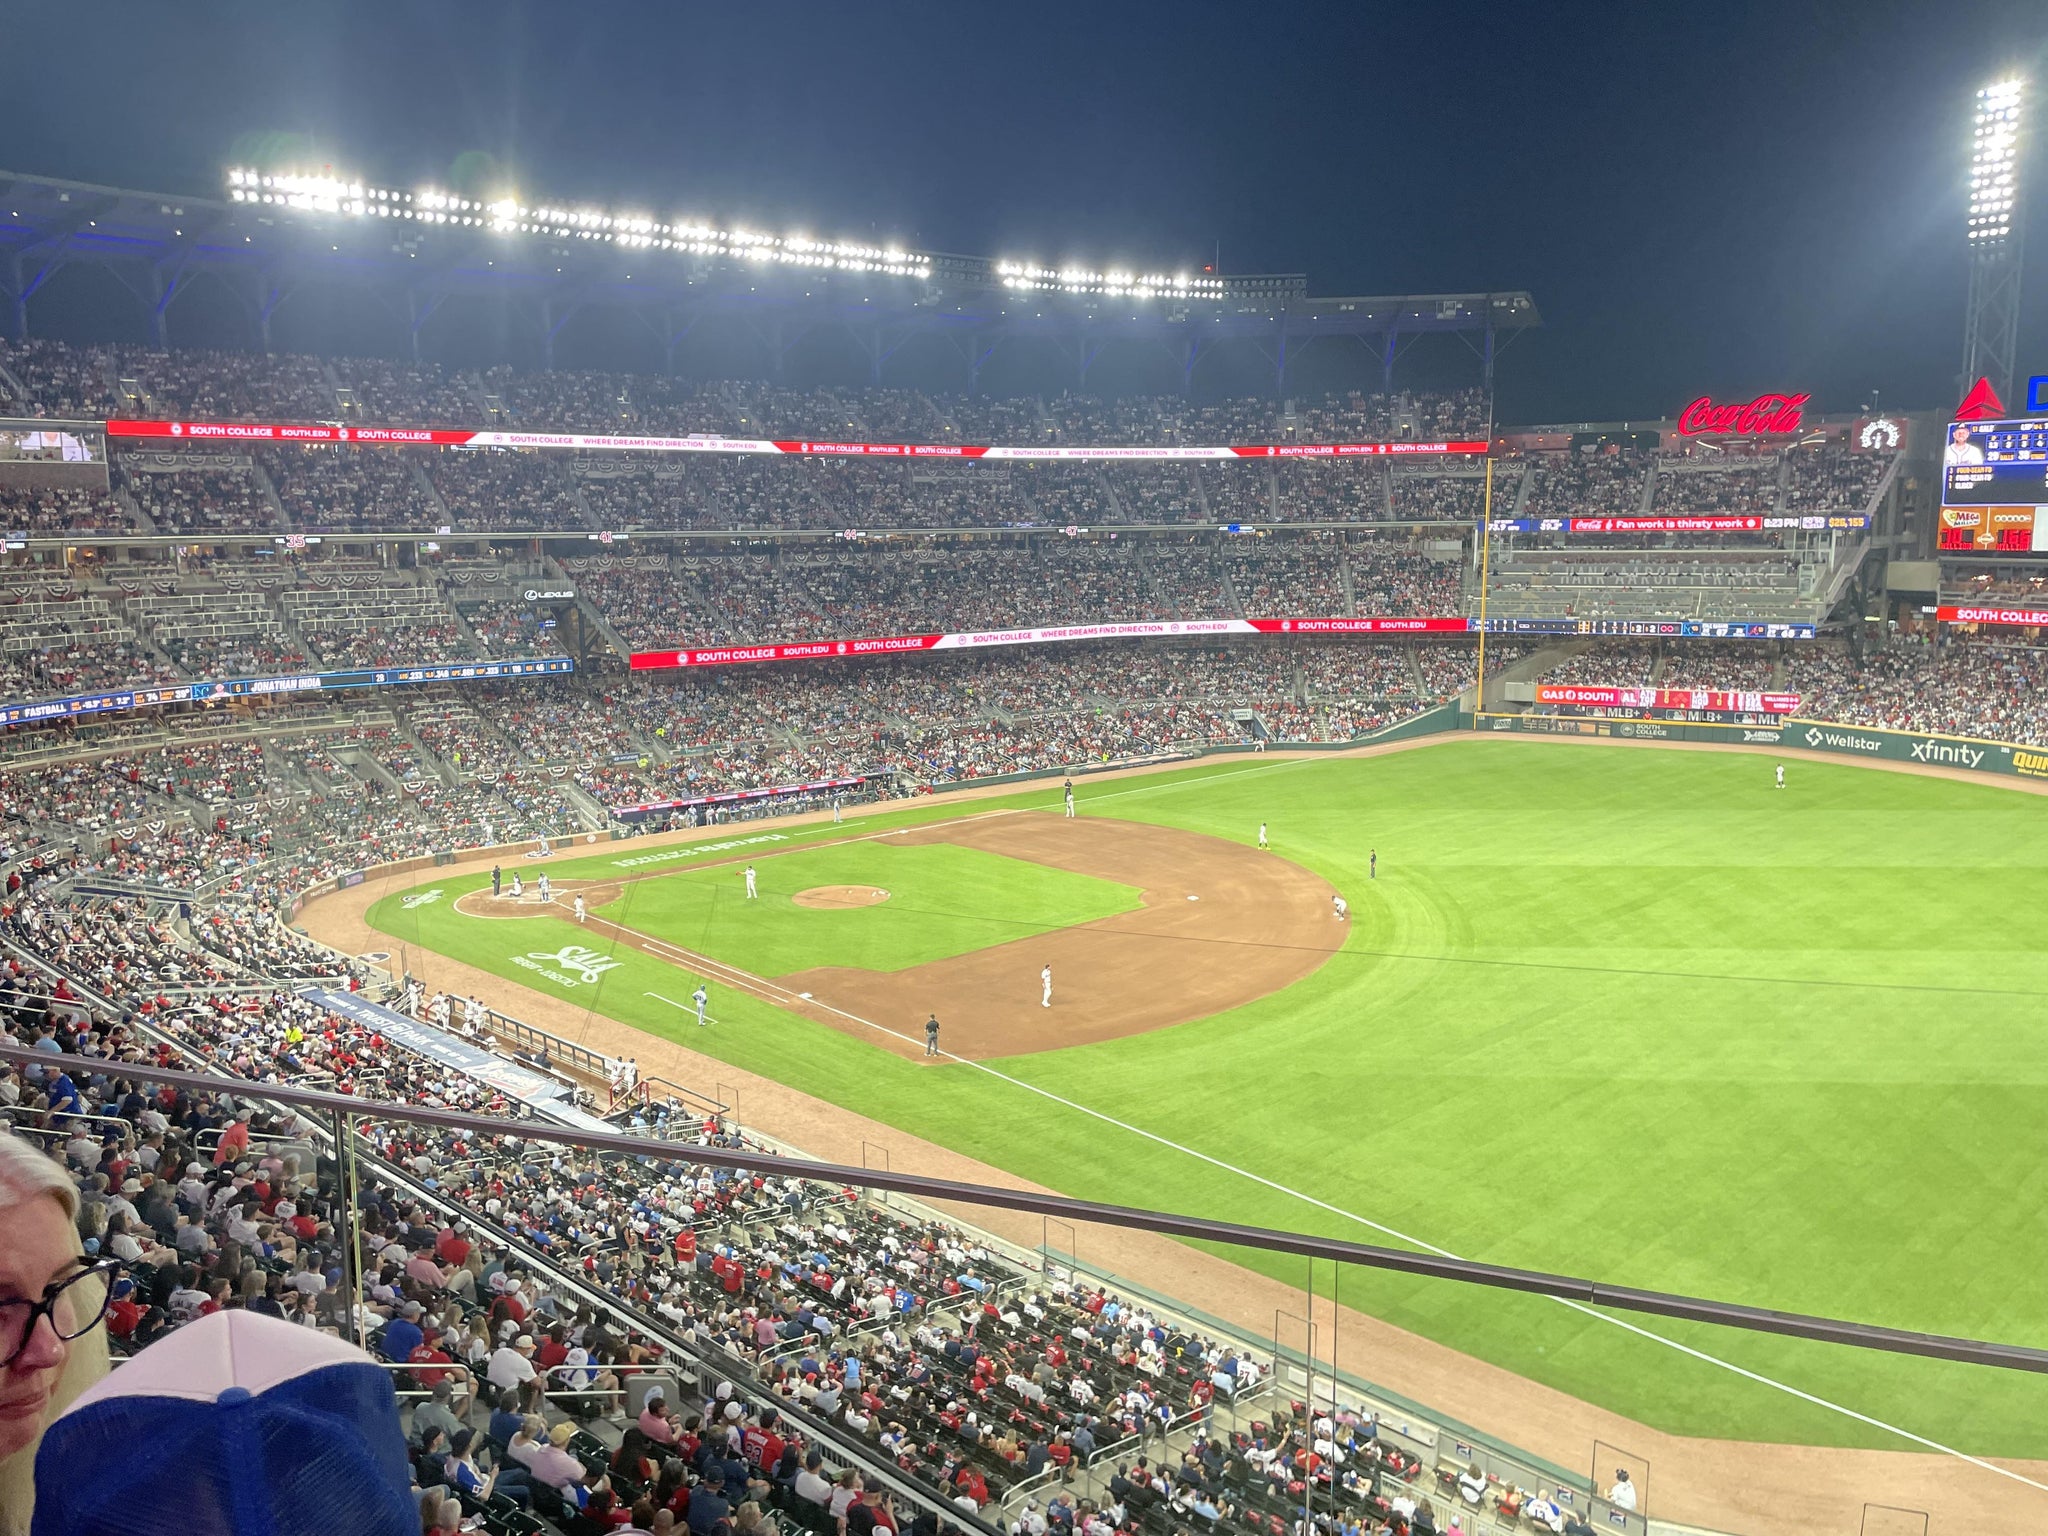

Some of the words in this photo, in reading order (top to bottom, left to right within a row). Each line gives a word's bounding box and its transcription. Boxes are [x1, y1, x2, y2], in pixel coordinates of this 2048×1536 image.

[1678, 393, 1811, 437] Coca-Cola
[190, 425, 225, 435] SOUTH
[227, 426, 273, 437] COLLEGE
[281, 428, 331, 438] SOUTH.EDU
[357, 430, 391, 440] SOUTH
[391, 431, 432, 441] COLLEGE
[510, 435, 537, 443] SOUTH
[539, 436, 574, 445] COLLEGE
[583, 438, 611, 446] WHERE
[613, 439, 645, 447] DREAMS
[665, 440, 704, 448] DIRECTION
[813, 444, 835, 453] SOUTH
[836, 445, 864, 454] COLLEGE
[915, 446, 935, 455] SOUTH
[936, 447, 962, 455] COLLEGE
[1279, 447, 1304, 455] SOUTH
[1305, 446, 1334, 454] COLLEGE
[1616, 520, 1634, 528] Fan
[1636, 520, 1664, 528] work
[1666, 519, 1675, 528] is
[1677, 519, 1713, 530] thirsty
[1715, 519, 1743, 528] work
[1784, 517, 1799, 528] PM
[599, 531, 613, 543] 41
[843, 529, 857, 540] 44
[286, 534, 306, 548] 35
[1561, 566, 1610, 585] HANK
[1614, 566, 1680, 585] AARON
[1690, 566, 1779, 586] TERRACE
[538, 590, 574, 598] LEXUS
[1957, 609, 1999, 621] SOUTH
[1186, 623, 1228, 632] SOUTH.EDU
[1297, 620, 1329, 630] SOUTH
[1331, 620, 1372, 630] COLLEGE
[1380, 621, 1427, 630] SOUTH.EDU
[1041, 630, 1066, 638] WHERE
[1067, 628, 1098, 637] DREAMS
[1099, 626, 1117, 635] FIND
[1118, 625, 1163, 634] DIRECTION
[973, 635, 999, 643] SOUTH
[1000, 632, 1032, 641] COLLEGE
[854, 640, 883, 651] SOUTH
[885, 638, 923, 649] COLLEGE
[696, 650, 730, 662] SOUTH
[732, 648, 776, 660] COLLEGE
[783, 645, 830, 656] SOUTH.EDU
[251, 679, 298, 692] JONATHAN
[299, 677, 321, 688] INDIA
[147, 693, 158, 702] 74
[1542, 690, 1564, 700] GAS
[1577, 691, 1614, 702] SOUTH
[1622, 693, 1637, 703] AL
[24, 703, 67, 718] FASTBALL
[1607, 707, 1640, 718] MLB+
[1688, 711, 1722, 722] MLB+
[1825, 733, 1882, 751] Wellstar
[1910, 739, 1985, 768] xfinity
[355, 1008, 395, 1031] TRUIST
[402, 1026, 434, 1047] PARK
